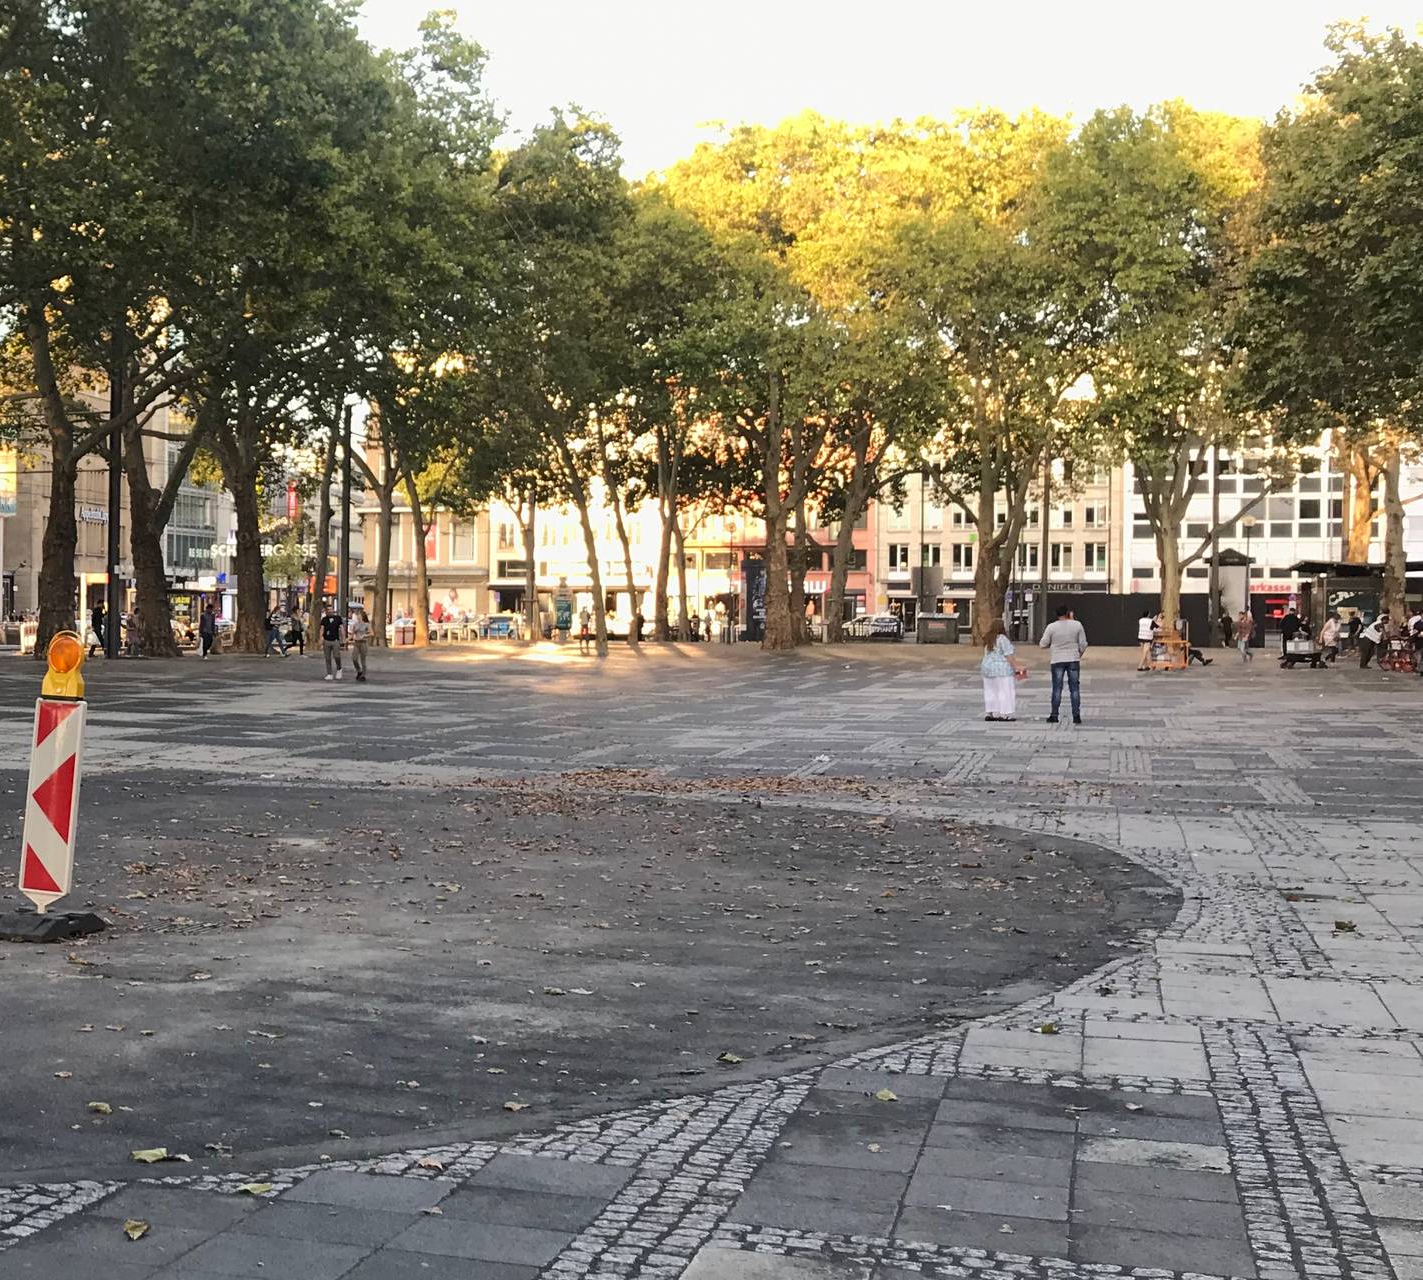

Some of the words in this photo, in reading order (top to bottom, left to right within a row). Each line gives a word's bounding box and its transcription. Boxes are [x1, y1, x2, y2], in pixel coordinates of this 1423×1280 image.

[210, 543, 318, 558] SCHERGASSE
[1032, 583, 1082, 591] DNIELS
[1249, 583, 1292, 593] arkasse
